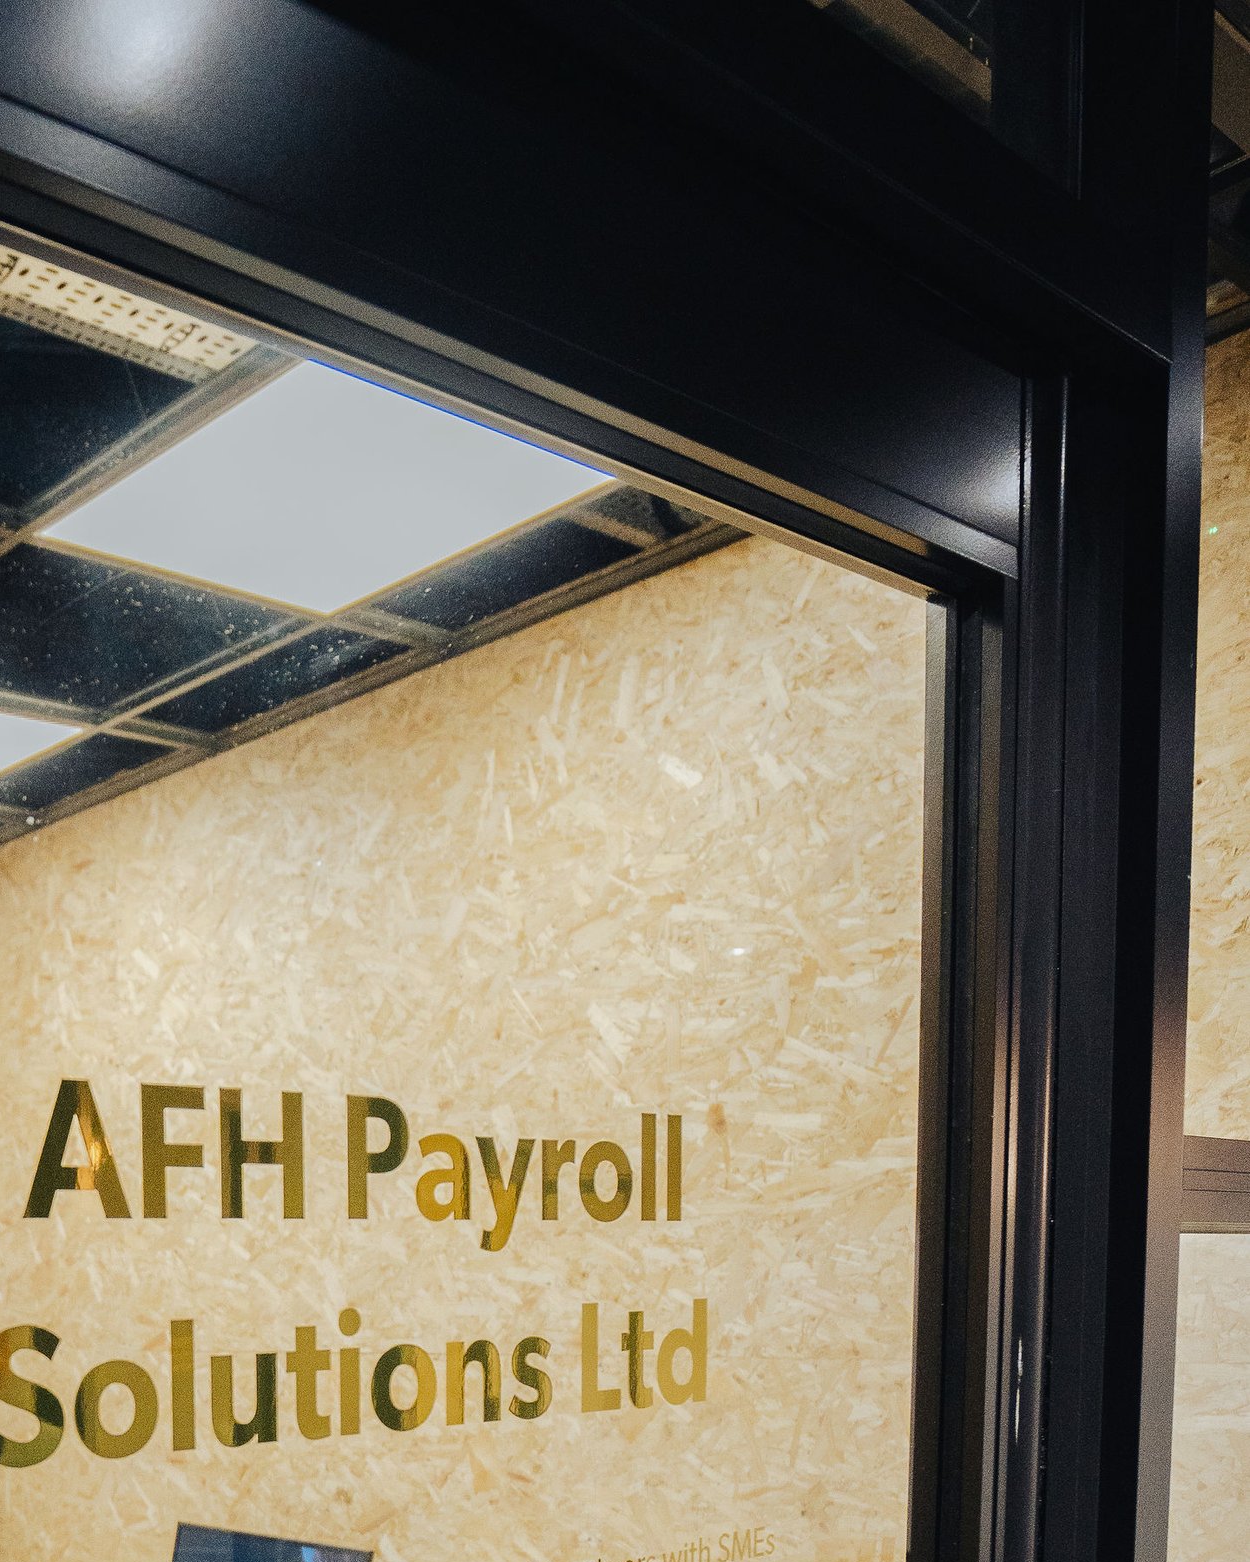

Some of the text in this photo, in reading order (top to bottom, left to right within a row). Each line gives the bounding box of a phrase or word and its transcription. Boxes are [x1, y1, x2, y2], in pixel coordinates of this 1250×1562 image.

[23, 1079, 682, 1252] AFH Payroll
[580, 1298, 708, 1414] Ltd
